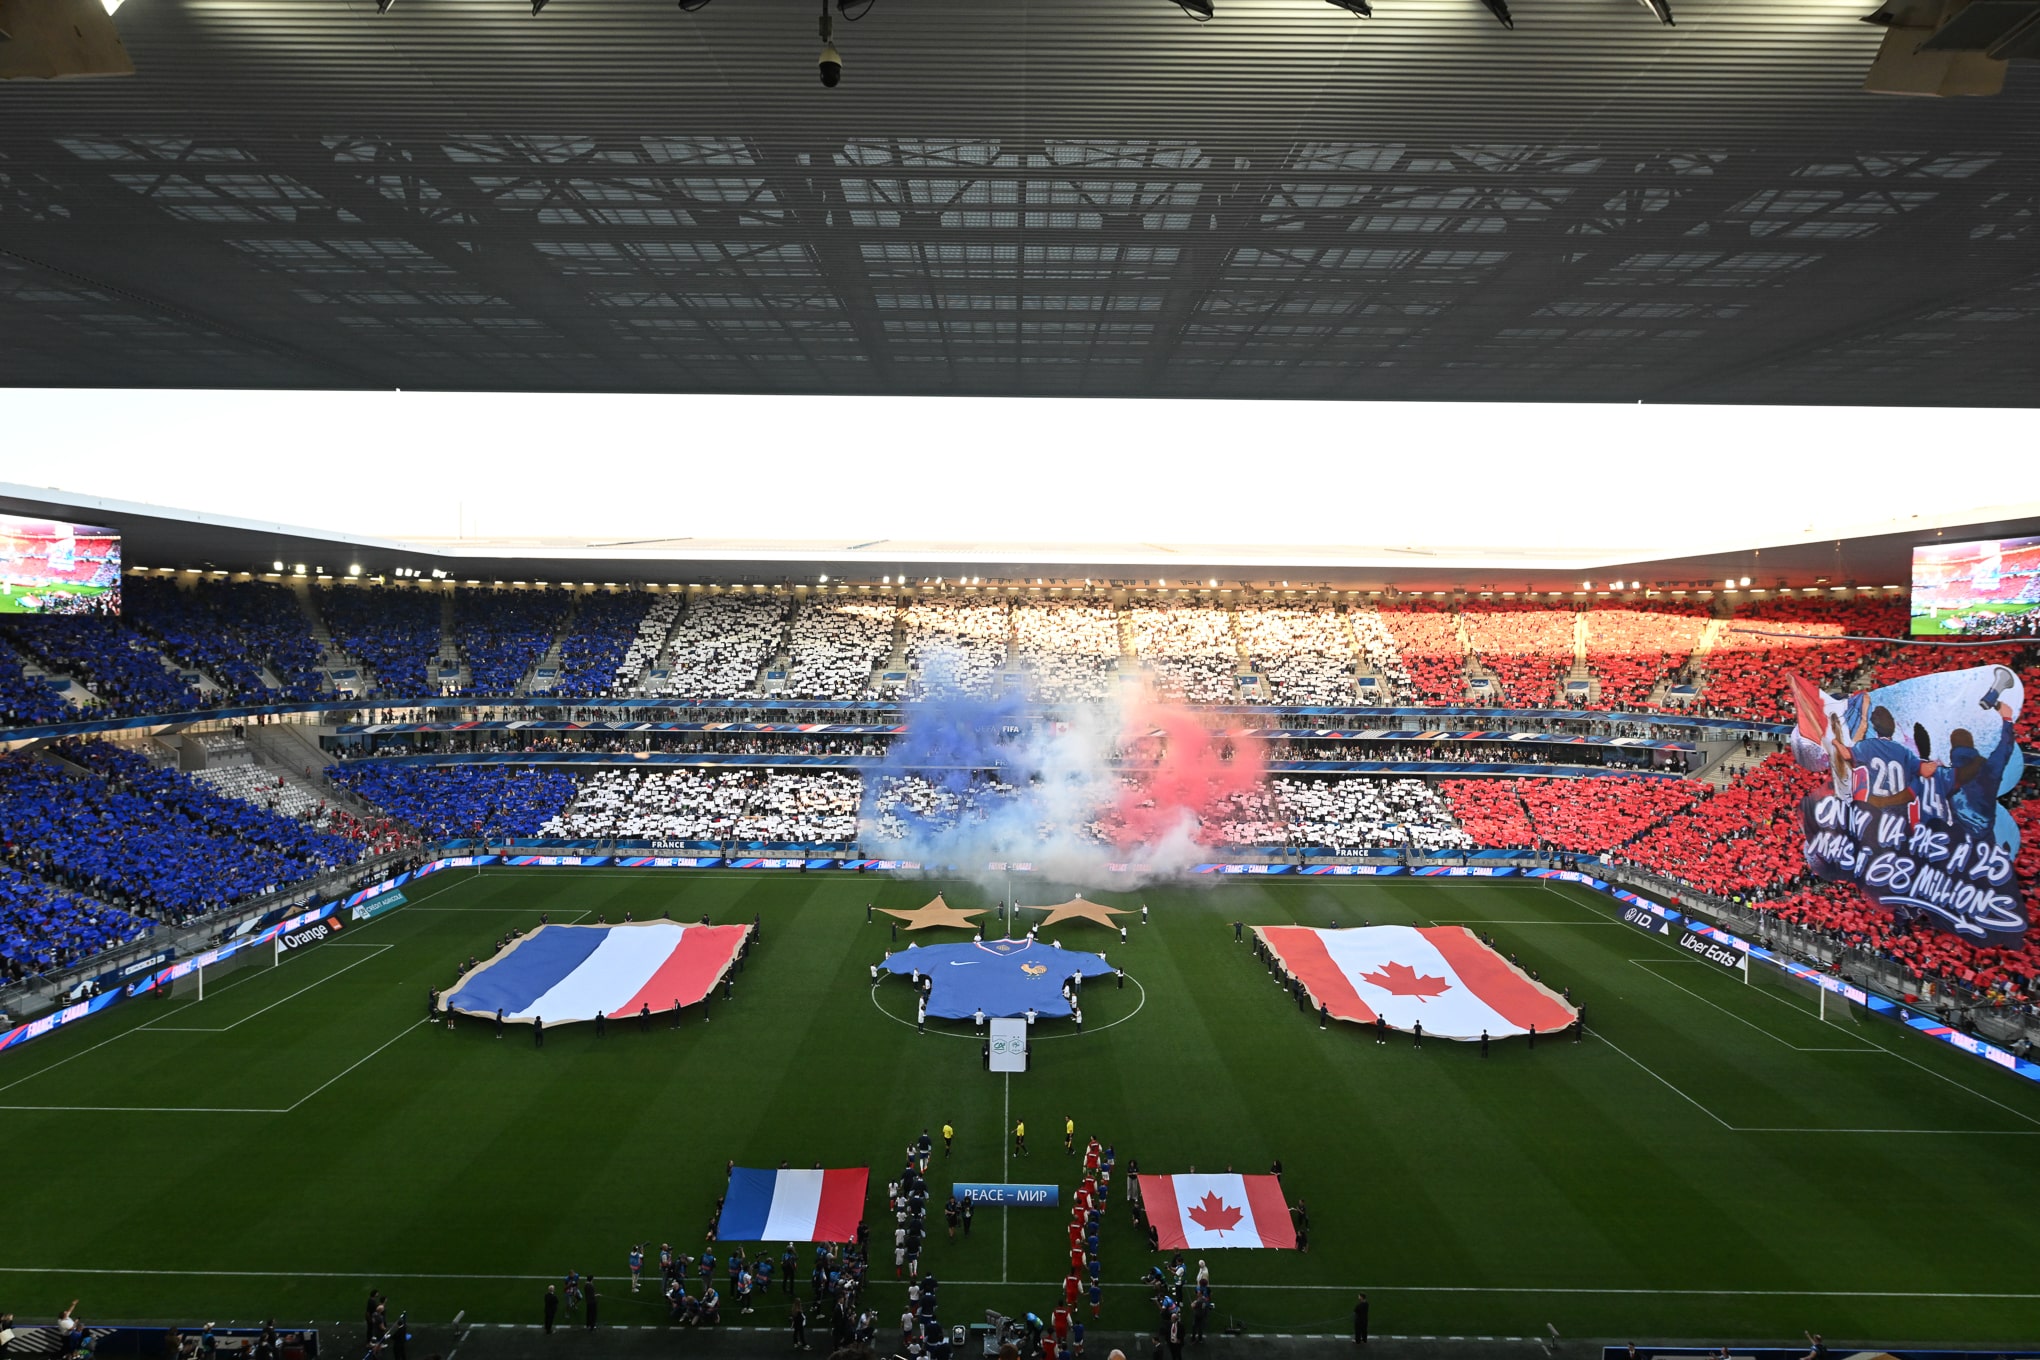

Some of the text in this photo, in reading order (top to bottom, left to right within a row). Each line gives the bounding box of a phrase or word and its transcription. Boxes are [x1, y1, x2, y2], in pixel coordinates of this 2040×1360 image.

[1002, 725, 1020, 733] FIFA
[1870, 757, 1905, 797] 20
[652, 841, 685, 849] FRANCE
[1815, 796, 1848, 830] ON
[1877, 813, 1906, 848] VA
[1909, 823, 1950, 862] PAS
[1969, 842, 2013, 886] 25
[1335, 849, 1369, 857] FRANCE
[539, 856, 582, 866] FRANCE CANADA
[654, 858, 698, 867] FRANCE CANADA
[762, 859, 782, 868] FRANCE
[878, 860, 897, 869] FRANCE
[1225, 865, 1269, 874] FRANCE CANADA
[1333, 866, 1378, 875] FRANCE CANADA
[1450, 867, 1494, 876] FRANCE CANADA
[1866, 852, 1915, 894] 68
[1560, 871, 1580, 881] FRANCE
[1633, 912, 1653, 929] ID.
[285, 924, 329, 949] Orange
[1680, 932, 1737, 968] Uber Eats
[964, 1189, 1004, 1201] PEACE
[1017, 1190, 1047, 1202] МИР
